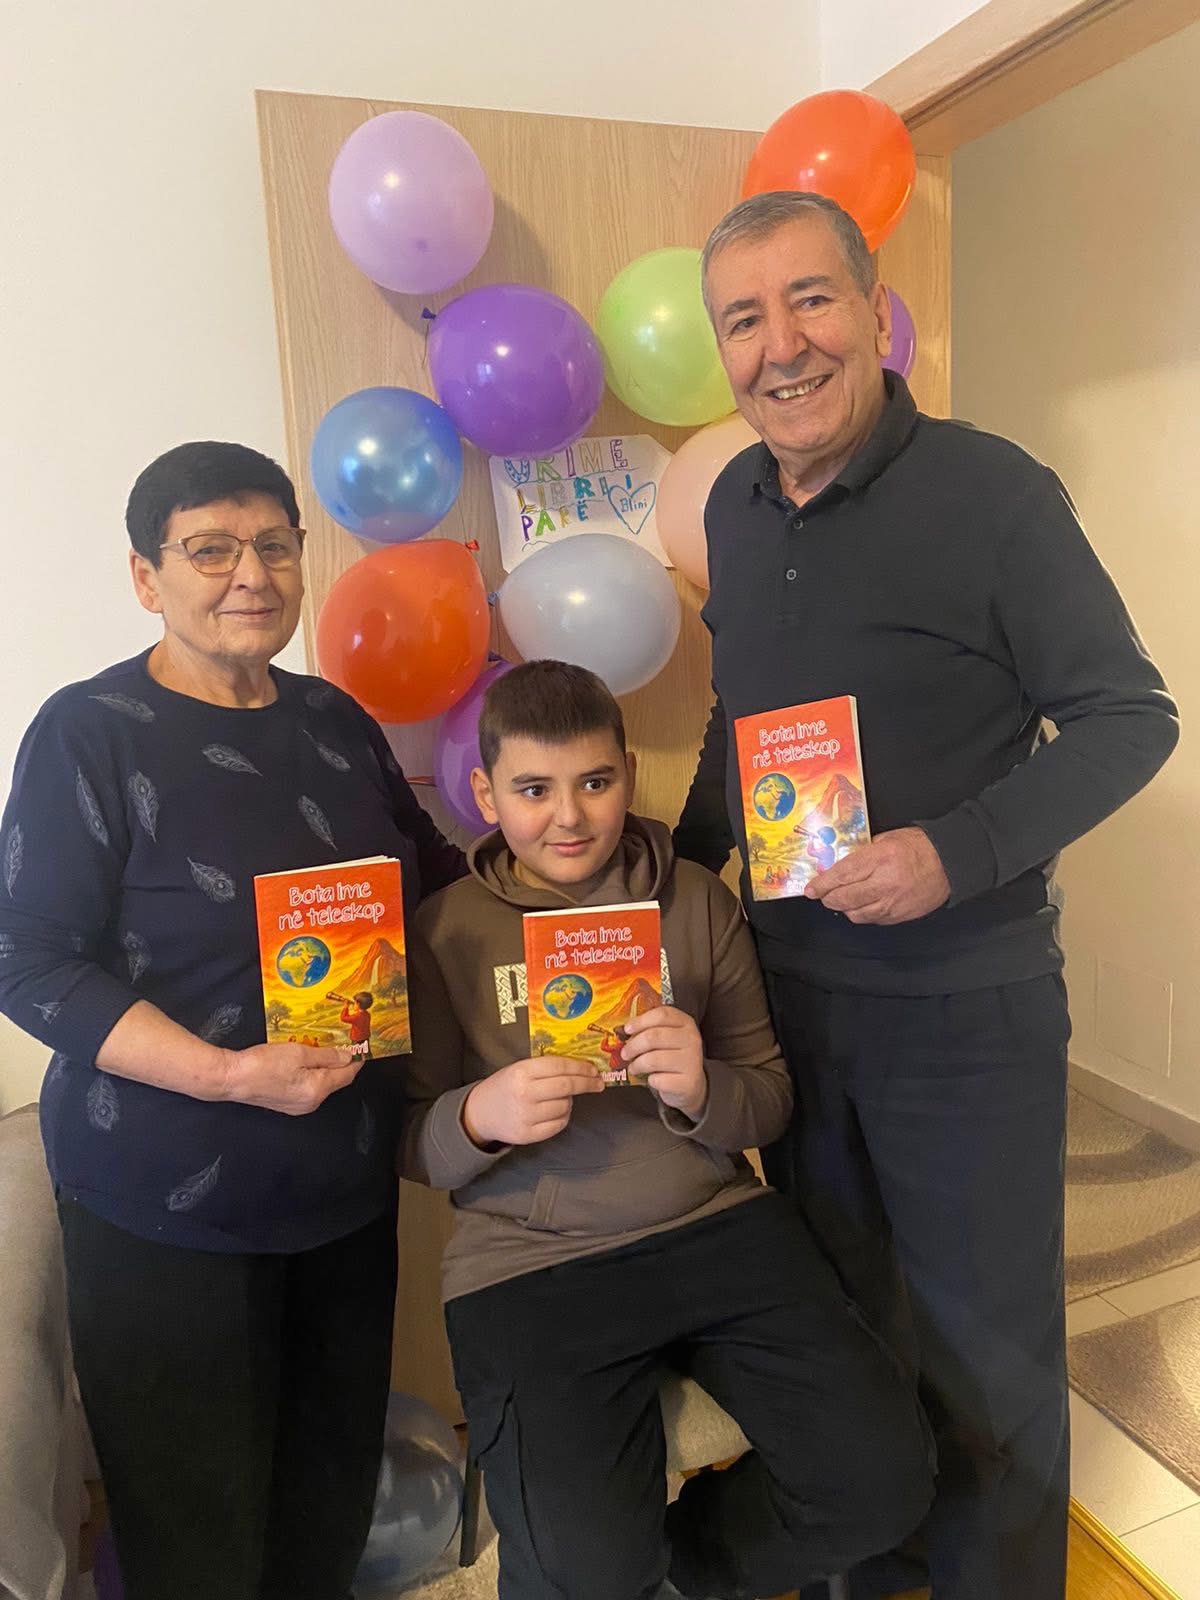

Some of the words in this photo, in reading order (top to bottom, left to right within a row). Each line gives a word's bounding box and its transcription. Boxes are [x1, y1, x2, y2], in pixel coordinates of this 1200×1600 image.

[503, 438, 629, 484] URIME
[516, 475, 609, 515] LIBRI
[619, 497, 648, 513] Blini
[519, 499, 589, 542] PARË
[759, 725, 796, 747] Bota
[752, 749, 773, 769] në
[773, 738, 841, 761] teleskop
[288, 884, 335, 907] Bota
[278, 909, 304, 931] në
[306, 902, 386, 927] teleskop
[555, 928, 598, 948] Bota
[544, 950, 569, 970] në
[570, 944, 645, 966] teleskop
